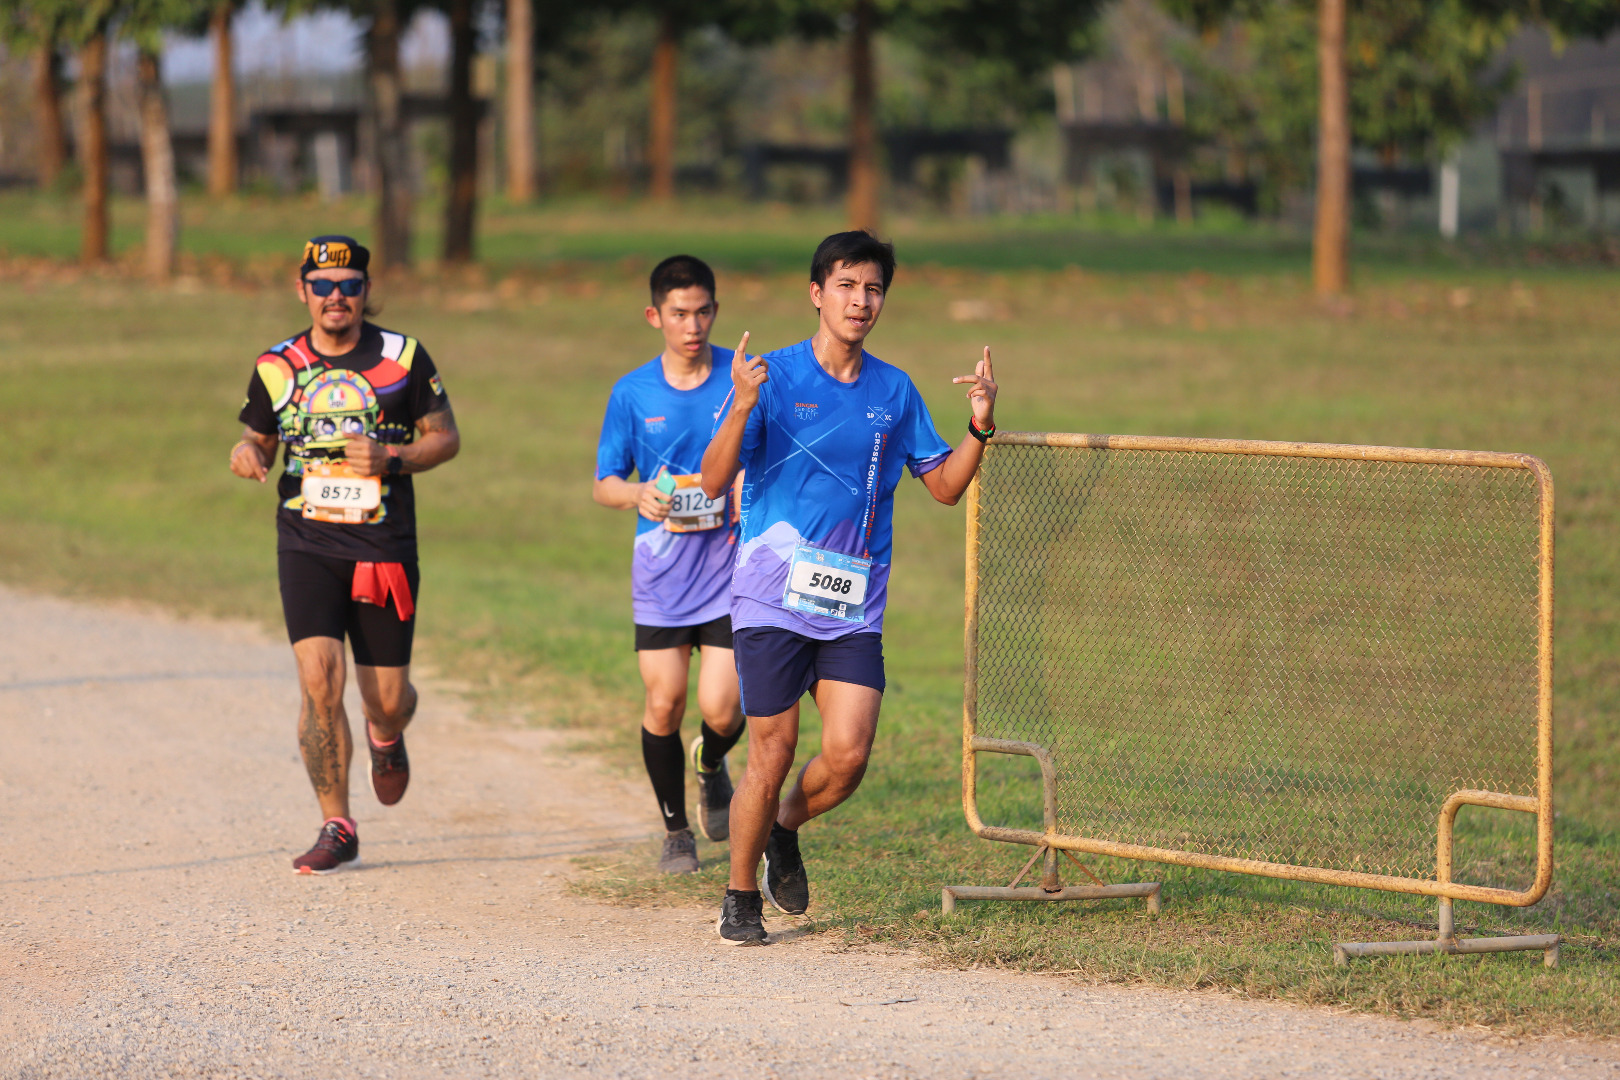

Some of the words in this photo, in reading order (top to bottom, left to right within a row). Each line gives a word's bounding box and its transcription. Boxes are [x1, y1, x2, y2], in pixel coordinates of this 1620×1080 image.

[871, 432, 881, 463] CROSS
[321, 485, 362, 500] 8573
[808, 572, 852, 595] 5088
